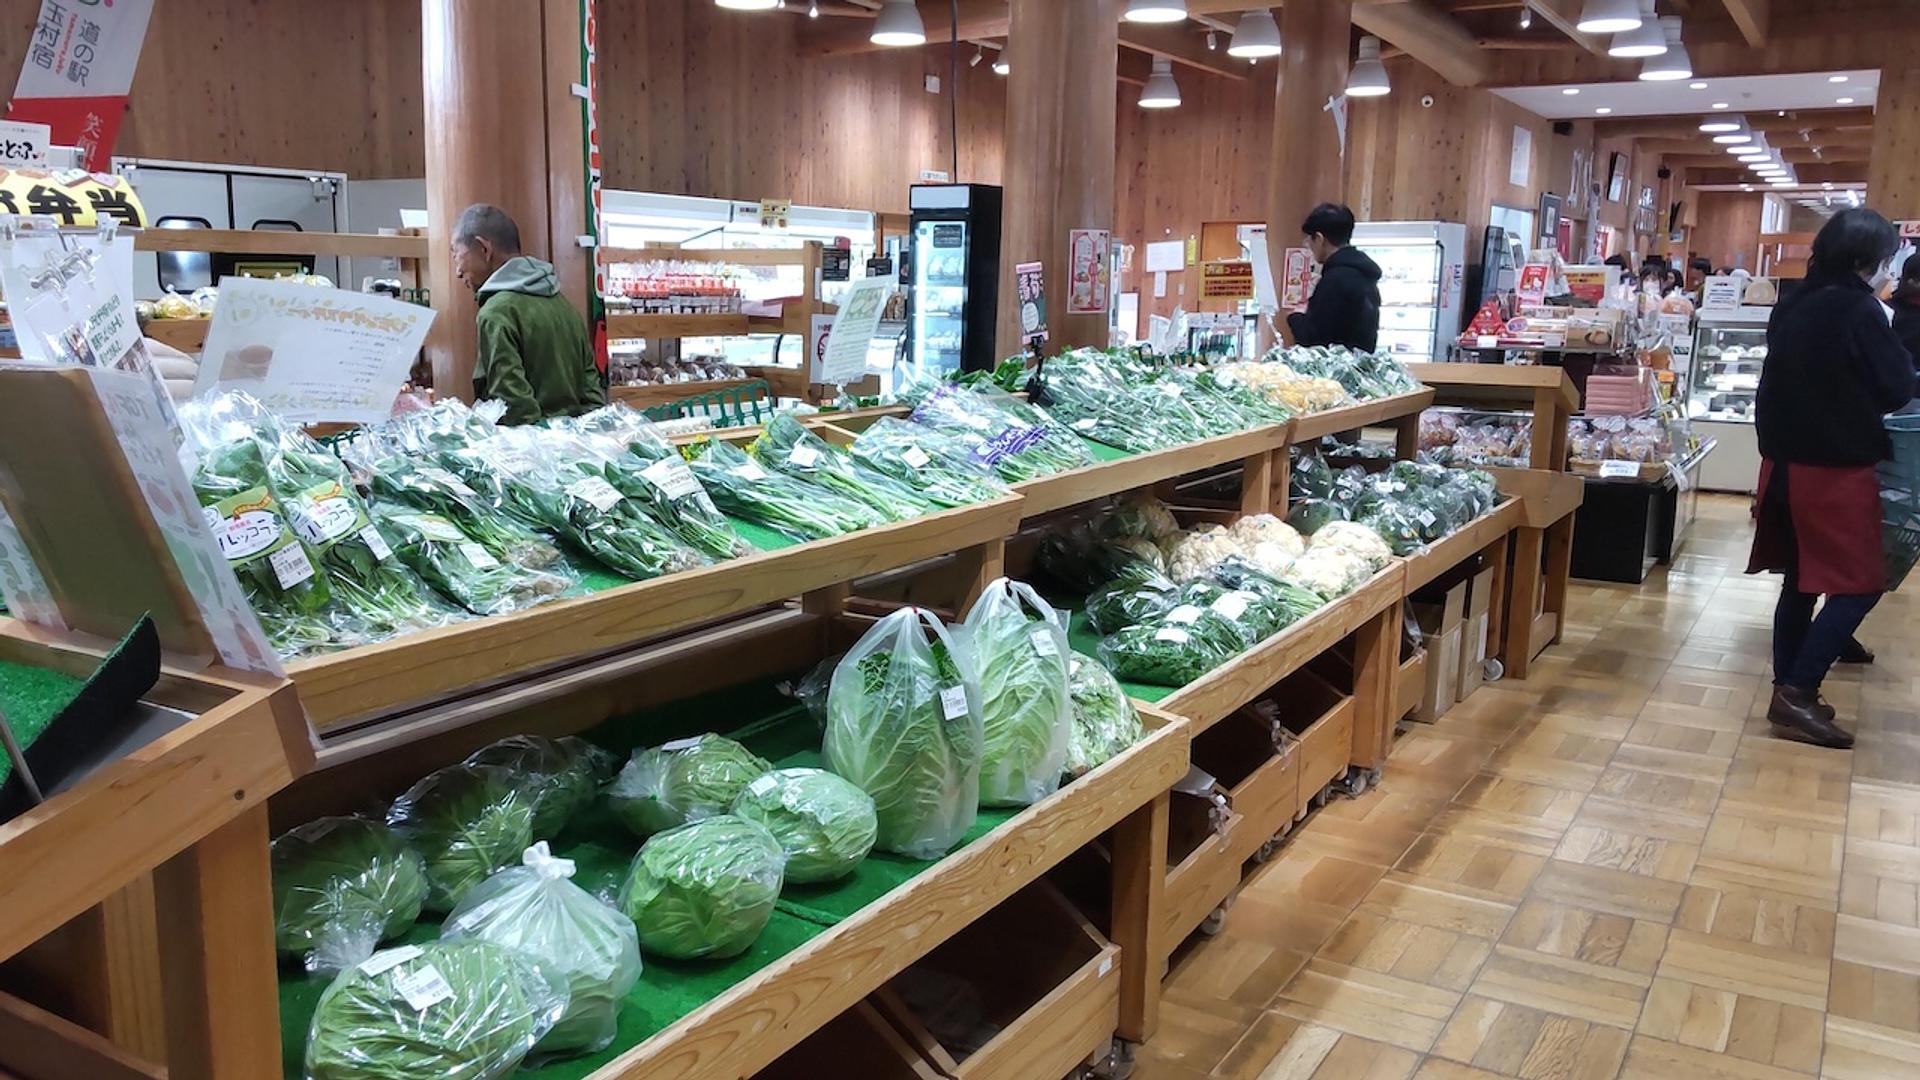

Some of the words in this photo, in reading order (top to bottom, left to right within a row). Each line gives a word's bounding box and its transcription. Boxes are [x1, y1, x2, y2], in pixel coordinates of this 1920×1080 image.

[31, 1, 68, 70] 玉村宿
[66, 18, 102, 88] 道の駅
[218, 518, 273, 552] ルッコラ
